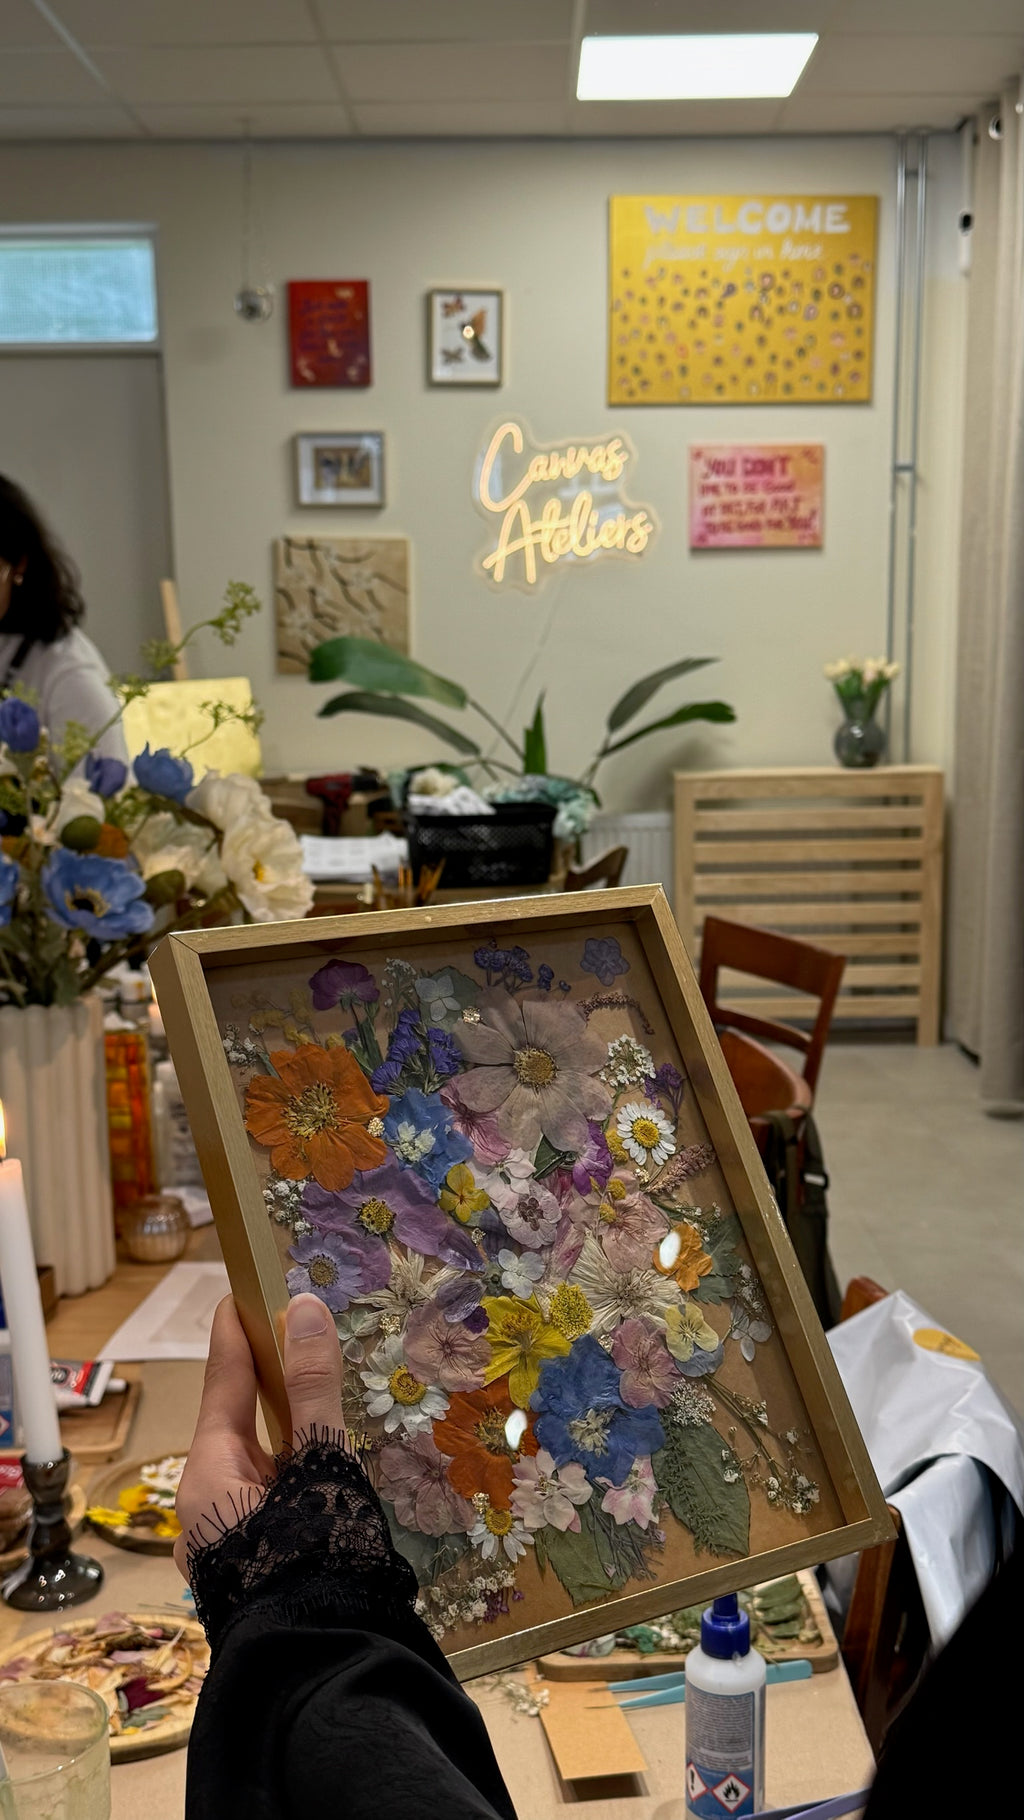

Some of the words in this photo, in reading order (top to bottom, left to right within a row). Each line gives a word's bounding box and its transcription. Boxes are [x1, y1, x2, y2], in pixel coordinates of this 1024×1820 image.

[643, 202, 851, 235] WELCOME
[480, 422, 628, 512] Canvas
[482, 490, 653, 584] Ateliers
